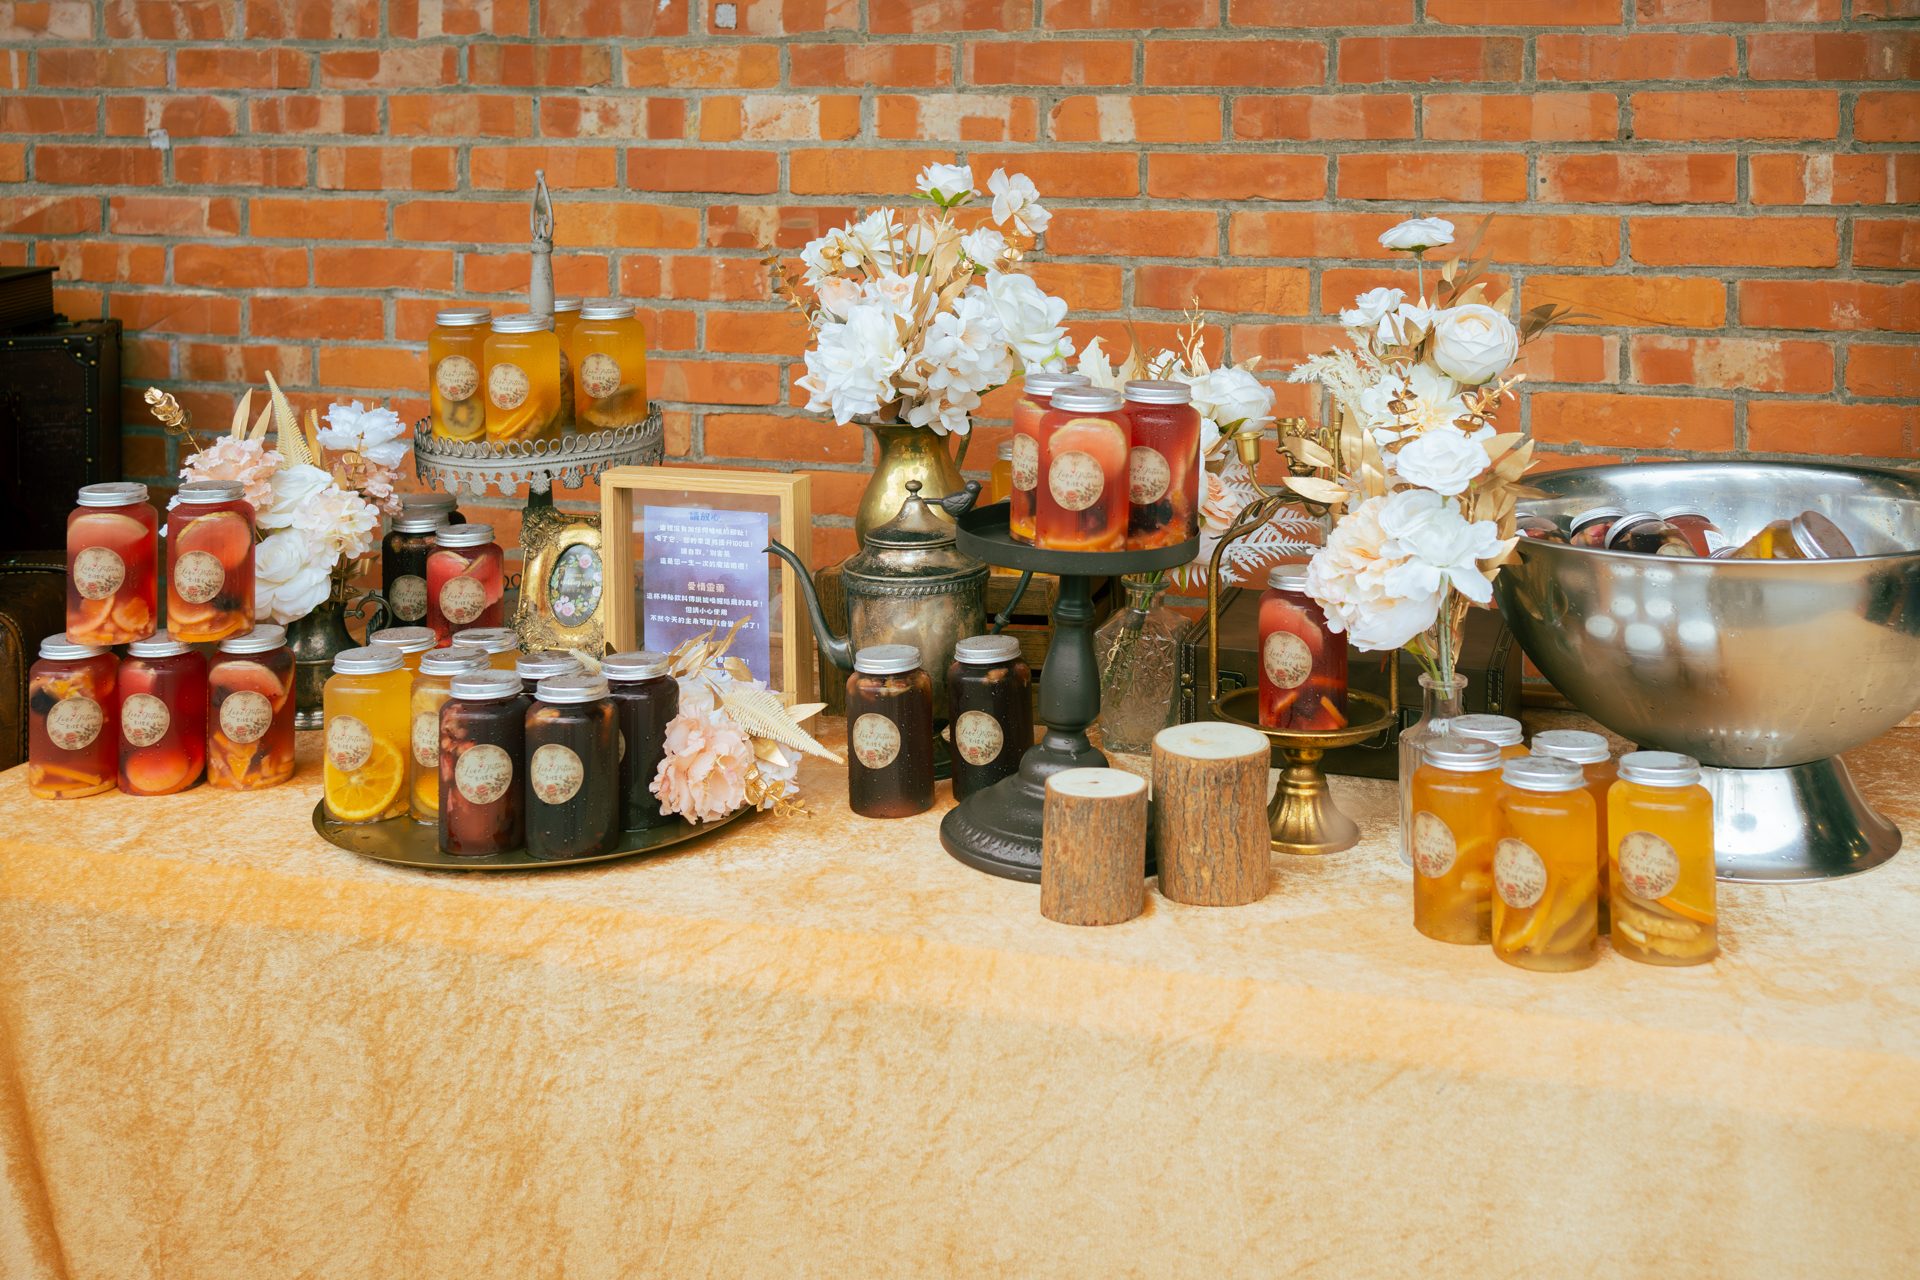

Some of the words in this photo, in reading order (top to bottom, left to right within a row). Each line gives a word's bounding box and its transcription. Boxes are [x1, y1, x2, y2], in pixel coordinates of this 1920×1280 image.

[687, 581, 725, 593] 愛情靈藥
[685, 606, 728, 616] 但請小心使用
